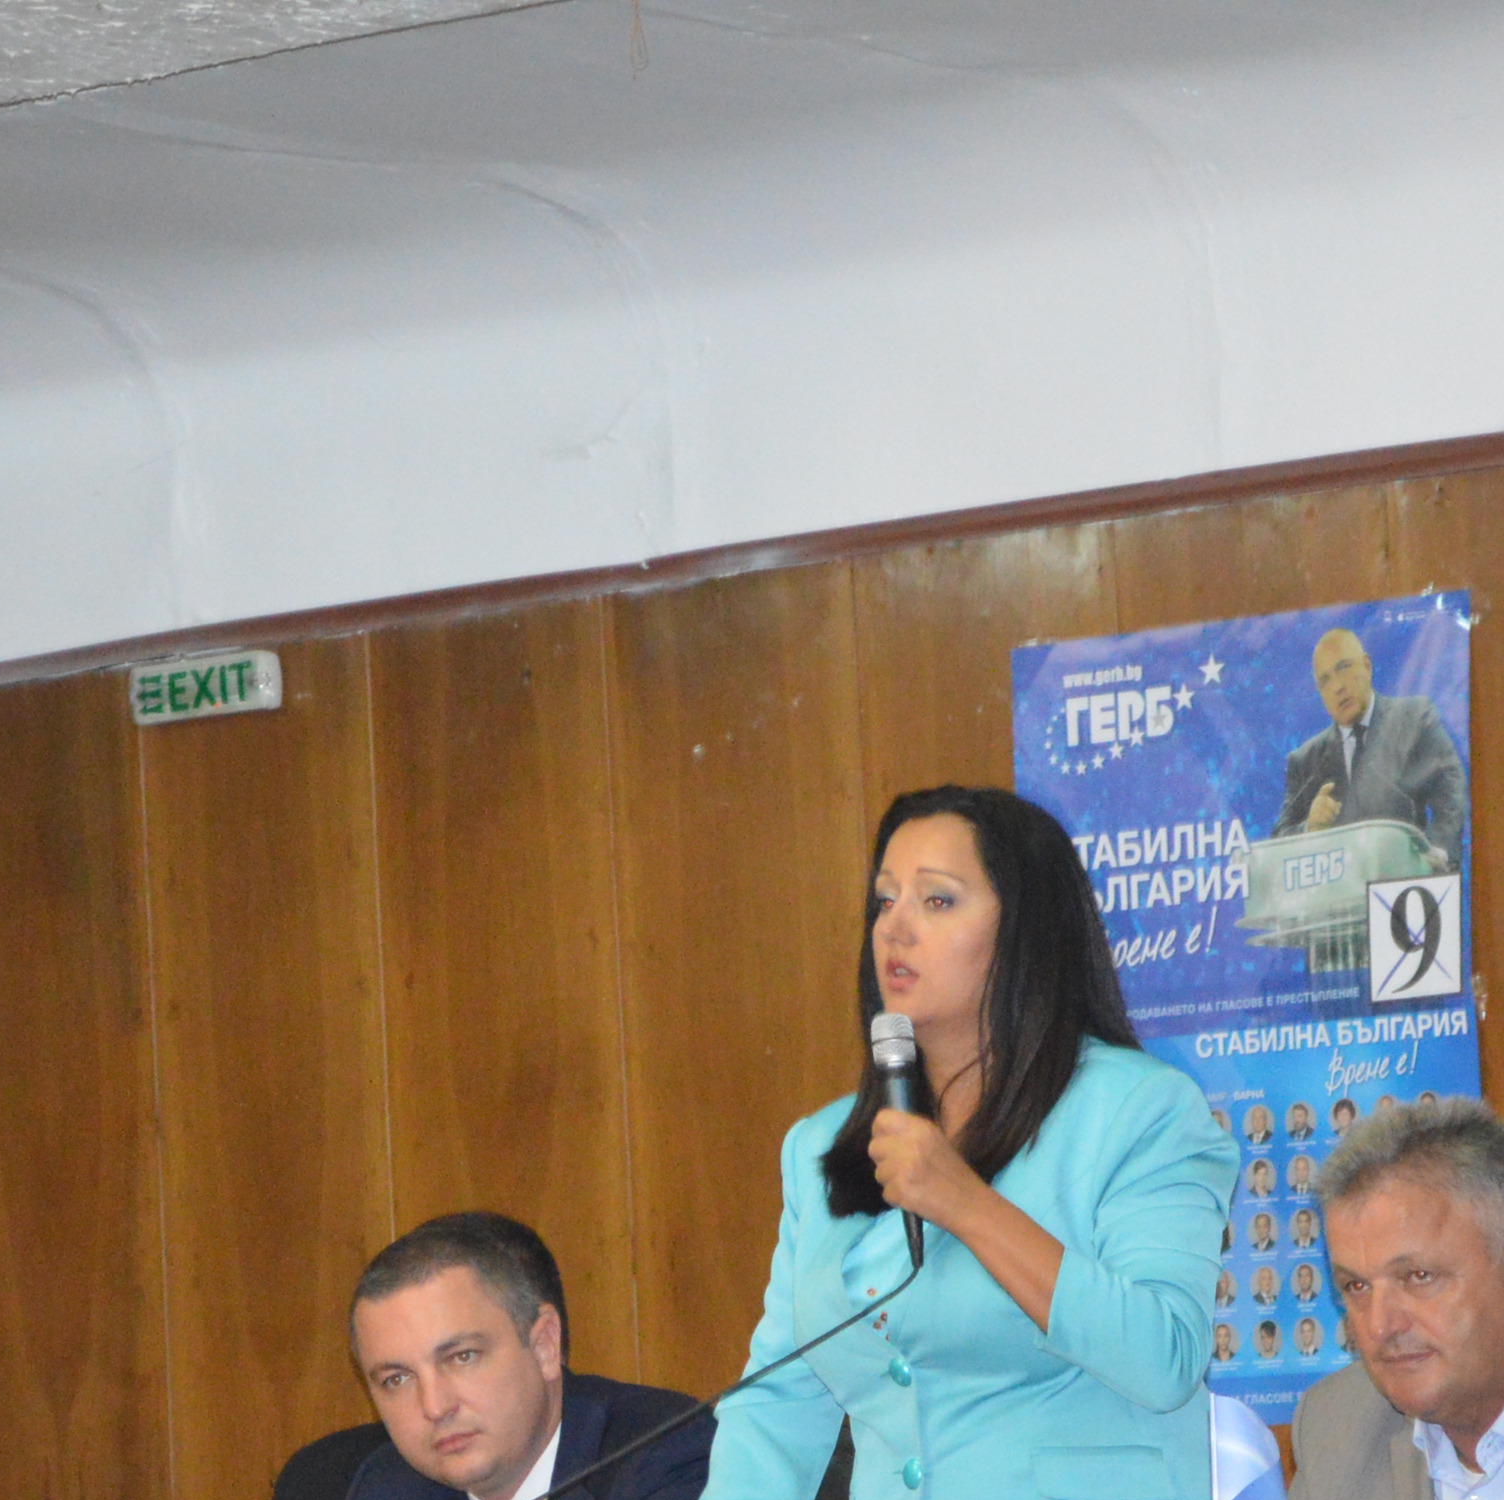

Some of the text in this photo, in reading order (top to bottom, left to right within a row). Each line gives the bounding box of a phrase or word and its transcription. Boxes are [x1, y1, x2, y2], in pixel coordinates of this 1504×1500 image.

[168, 660, 252, 712] EXIT
[1063, 664, 1142, 688] www.gerb.bg
[1066, 686, 1174, 747] ГЕРБ
[1072, 819, 1251, 870] ТАБИЛНА
[1283, 847, 1345, 892] ГЕРБ
[1390, 885, 1442, 994] 9
[1126, 1004, 1196, 1020] РОДАВАНЕТО
[1198, 1003, 1213, 1013] НА
[1215, 998, 1263, 1012] ГЛАСОВЕ
[1196, 1010, 1469, 1057] СТАБИЛНА БЪЛГАРИЯ
